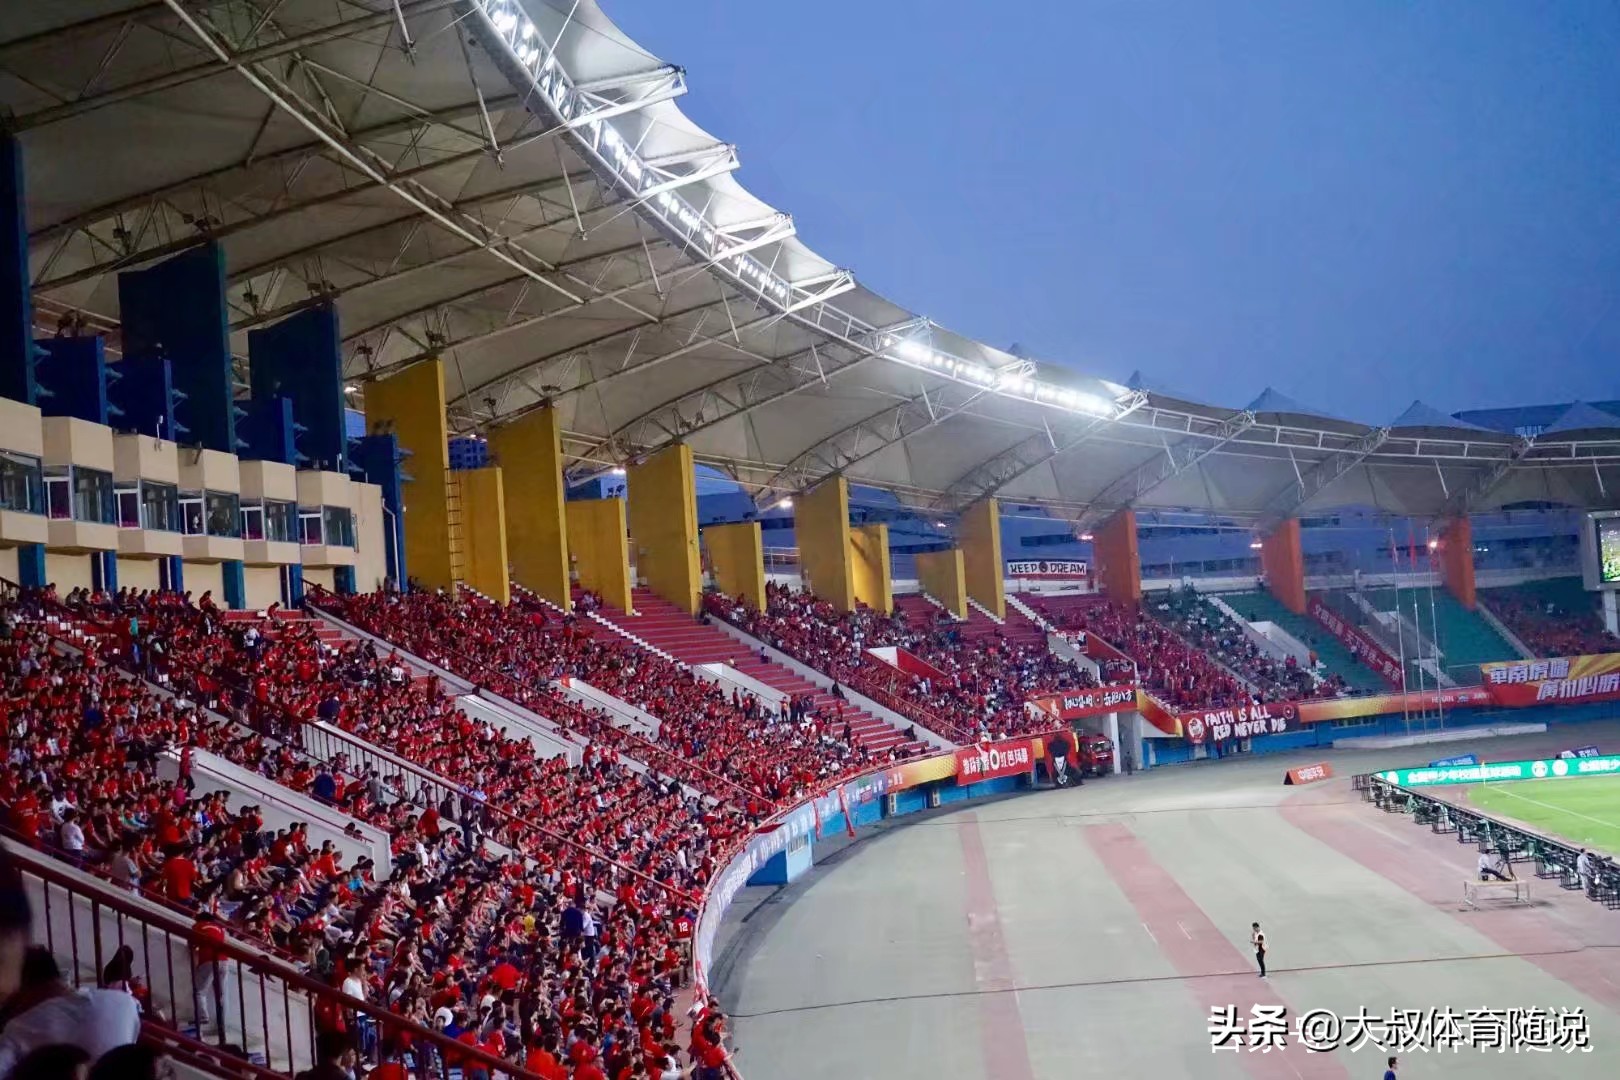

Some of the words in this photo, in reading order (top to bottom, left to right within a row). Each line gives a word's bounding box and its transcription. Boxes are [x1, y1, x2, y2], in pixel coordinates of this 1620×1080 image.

[1010, 563, 1037, 574] KEEP
[1050, 562, 1085, 574] DREAM
[1204, 709, 1235, 728] FAITH
[1238, 708, 1247, 722] IS
[1250, 705, 1272, 720] ALL
[1213, 724, 1232, 741] RED
[1234, 719, 1268, 737] NEVER
[1271, 717, 1287, 733] DIE
[678, 921, 689, 933] 12
